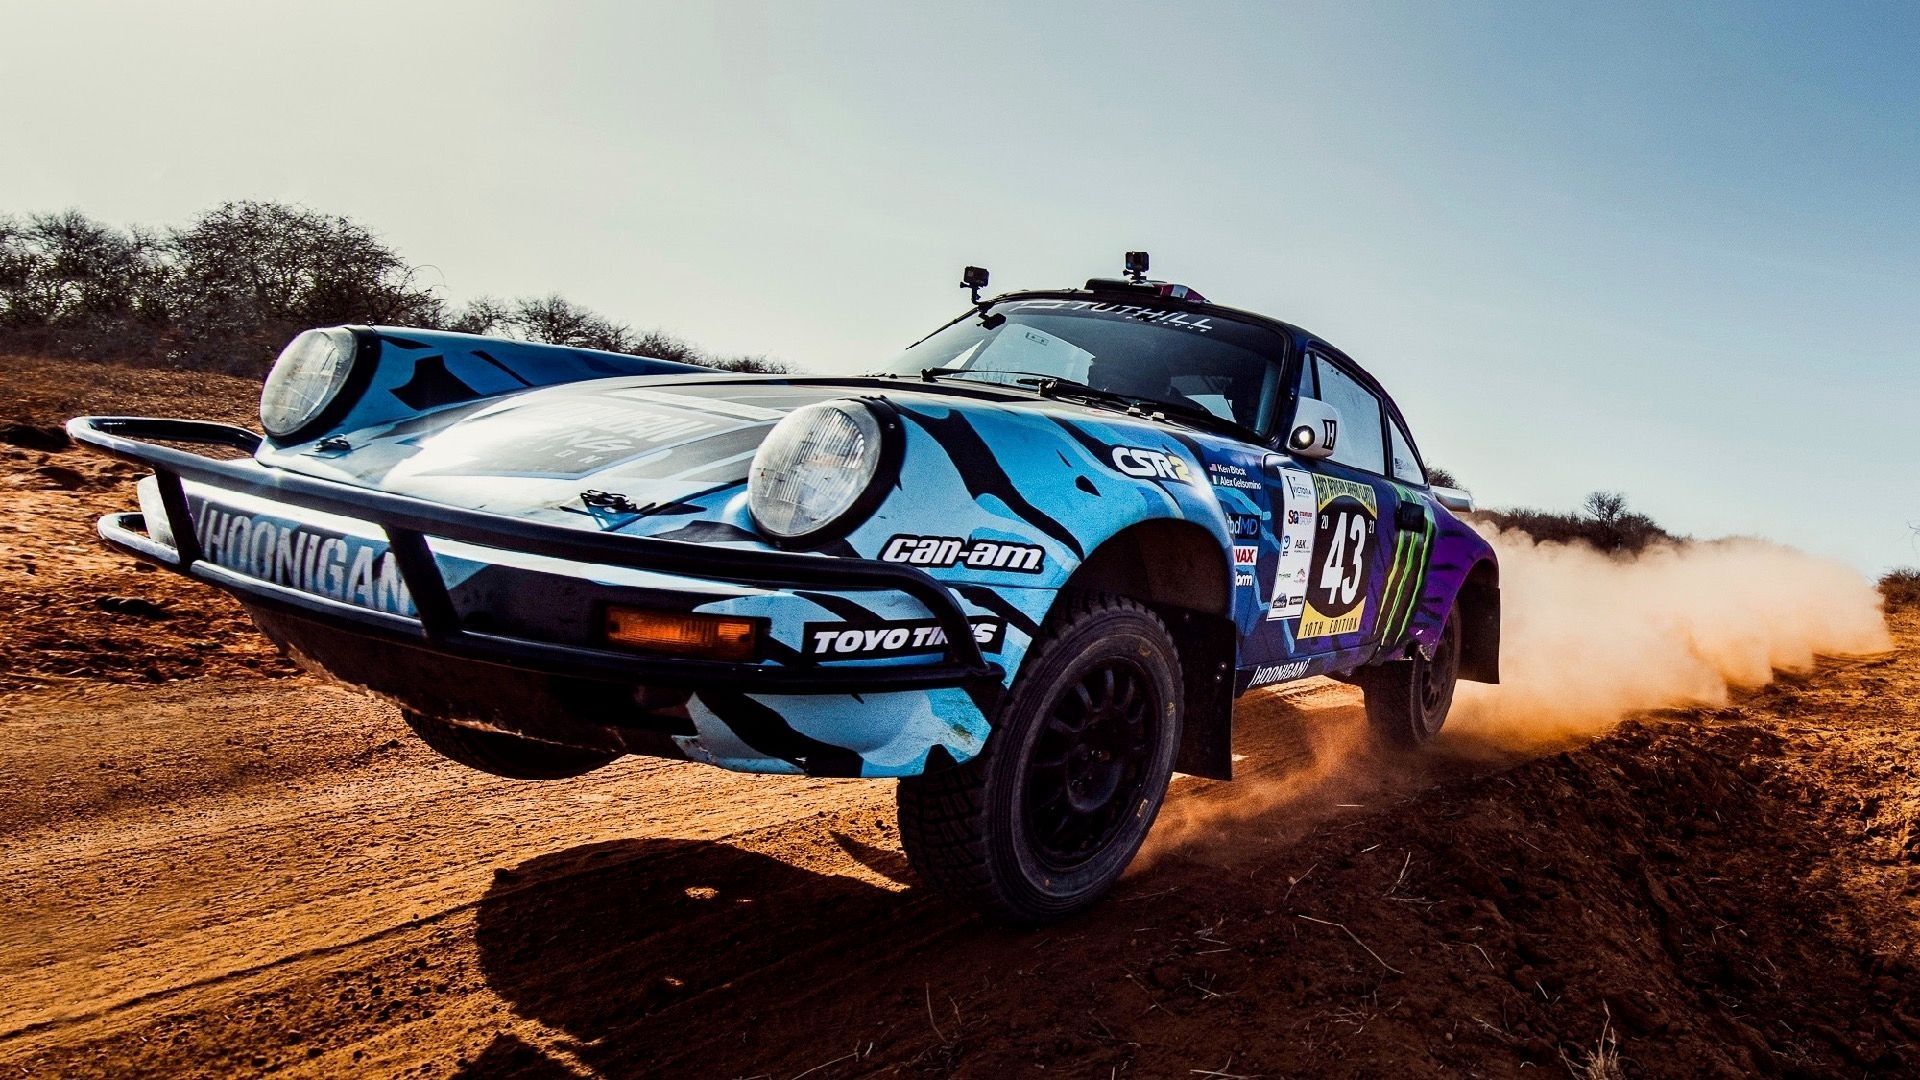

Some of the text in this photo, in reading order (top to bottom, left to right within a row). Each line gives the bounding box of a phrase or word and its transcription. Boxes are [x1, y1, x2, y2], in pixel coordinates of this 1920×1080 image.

[1072, 302, 1212, 330] TUTHILL
[1112, 447, 1193, 483] CSR2
[1217, 464, 1247, 476] Ken Block
[1220, 476, 1261, 490] Alex Gelsomino
[1227, 514, 1258, 535] bdMD
[1321, 515, 1329, 530] 20
[1369, 520, 1375, 534] 21
[883, 538, 1043, 570] can-am
[1320, 512, 1366, 605] 43
[1304, 617, 1357, 637] 10TH EDITION
[813, 623, 997, 654] TOYO TIS
